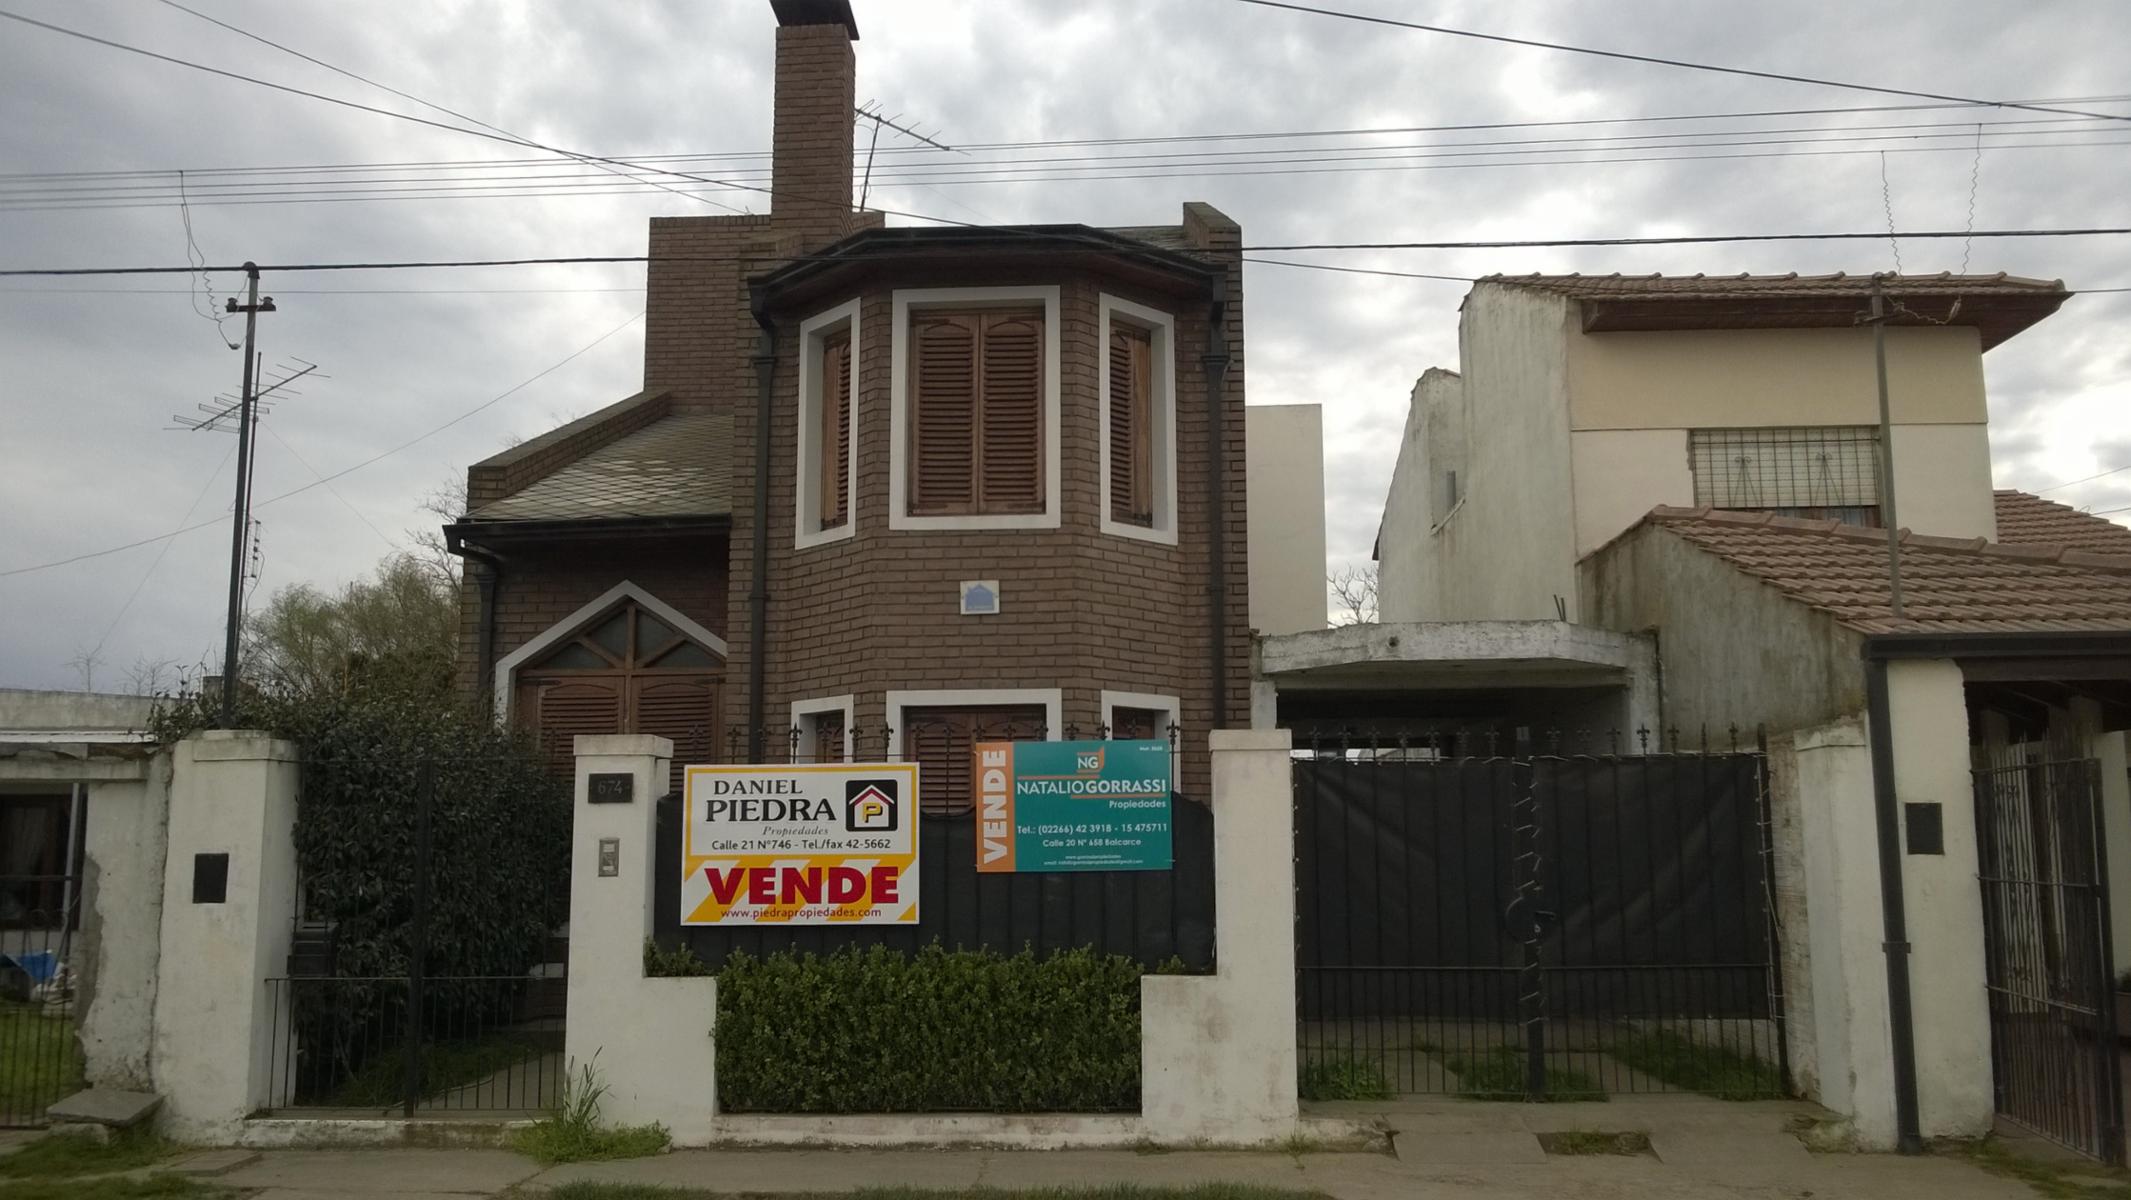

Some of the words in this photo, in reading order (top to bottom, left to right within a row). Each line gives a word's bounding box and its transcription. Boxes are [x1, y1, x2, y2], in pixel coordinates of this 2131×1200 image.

[1077, 756, 1099, 769] NG
[598, 780, 623, 794] 674
[714, 779, 803, 795] DANIEL
[705, 798, 837, 823] PIEDRA
[982, 750, 1008, 864] VENDE
[1109, 800, 1166, 809] Propiedades
[862, 802, 883, 823] P
[762, 825, 829, 837] Propiedades
[1017, 825, 1036, 835] Tel.:
[1038, 824, 1073, 836] (02266)
[1075, 824, 1087, 833] 42
[1122, 824, 1133, 832] 15
[1134, 823, 1167, 832] 475711
[712, 840, 738, 850] Calle
[741, 840, 754, 849] 21
[801, 839, 843, 850] Tel./fax
[846, 839, 891, 849] 42-5662
[1042, 839, 1064, 848] Calle
[1066, 839, 1076, 847] 20
[1104, 838, 1141, 846] Balcarce
[704, 866, 899, 905] VENDE
[720, 907, 882, 920] www.piedrapropiedades.com
